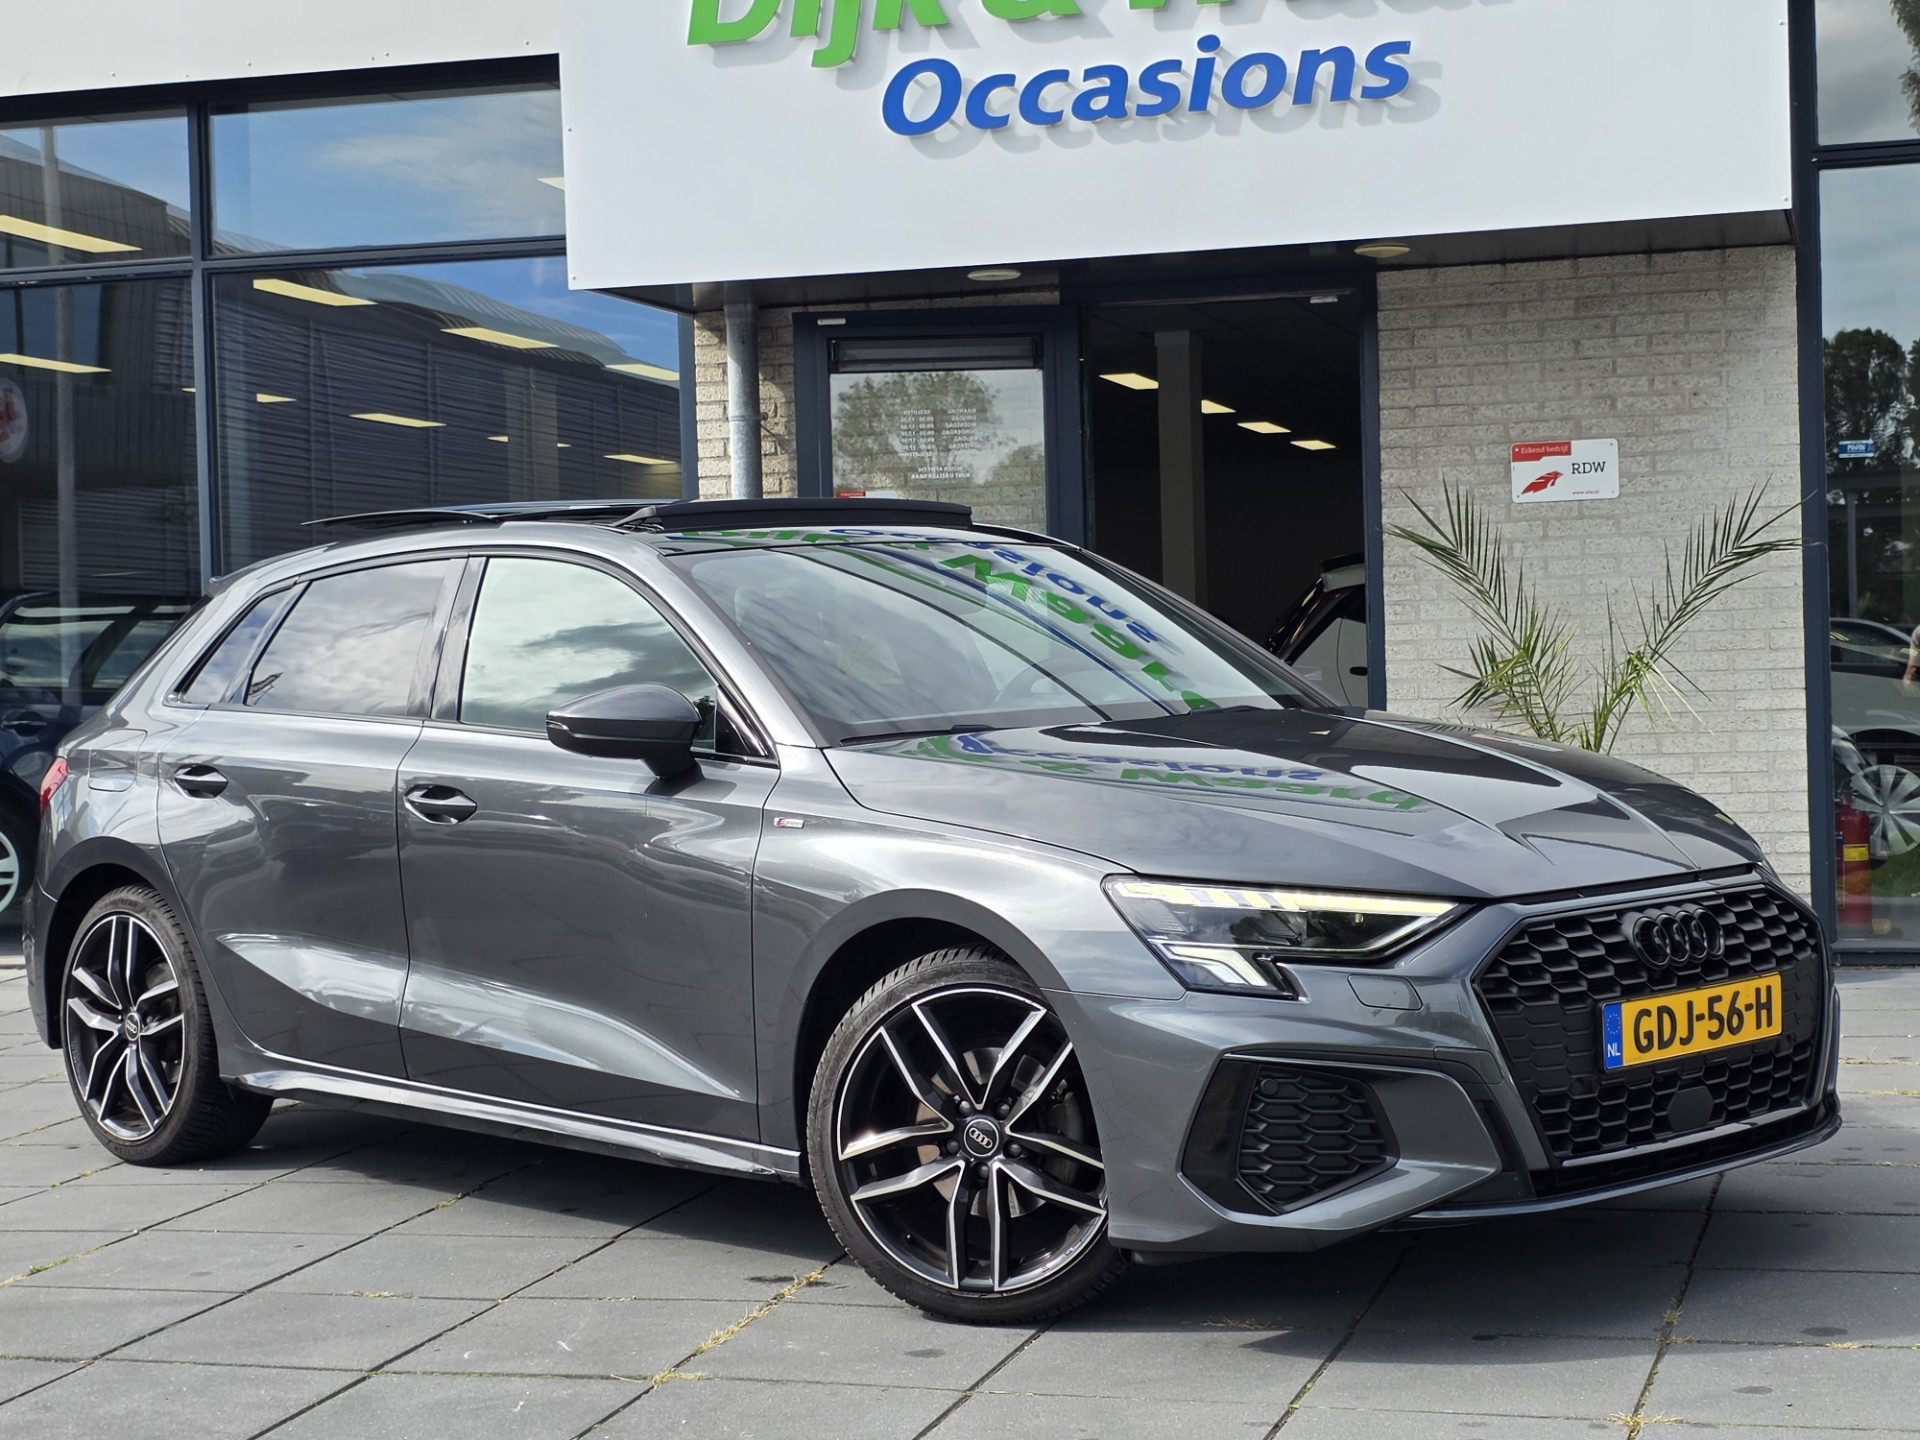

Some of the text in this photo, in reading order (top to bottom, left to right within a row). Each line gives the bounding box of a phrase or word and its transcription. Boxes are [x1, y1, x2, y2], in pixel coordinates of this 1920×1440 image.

[881, 34, 1411, 137] Occasions
[1520, 445, 1568, 454] Erkend bedrijf
[1571, 461, 1606, 475] RDW
[1633, 984, 1773, 1054] GDJ-56-H
[1607, 1043, 1621, 1058] NL
